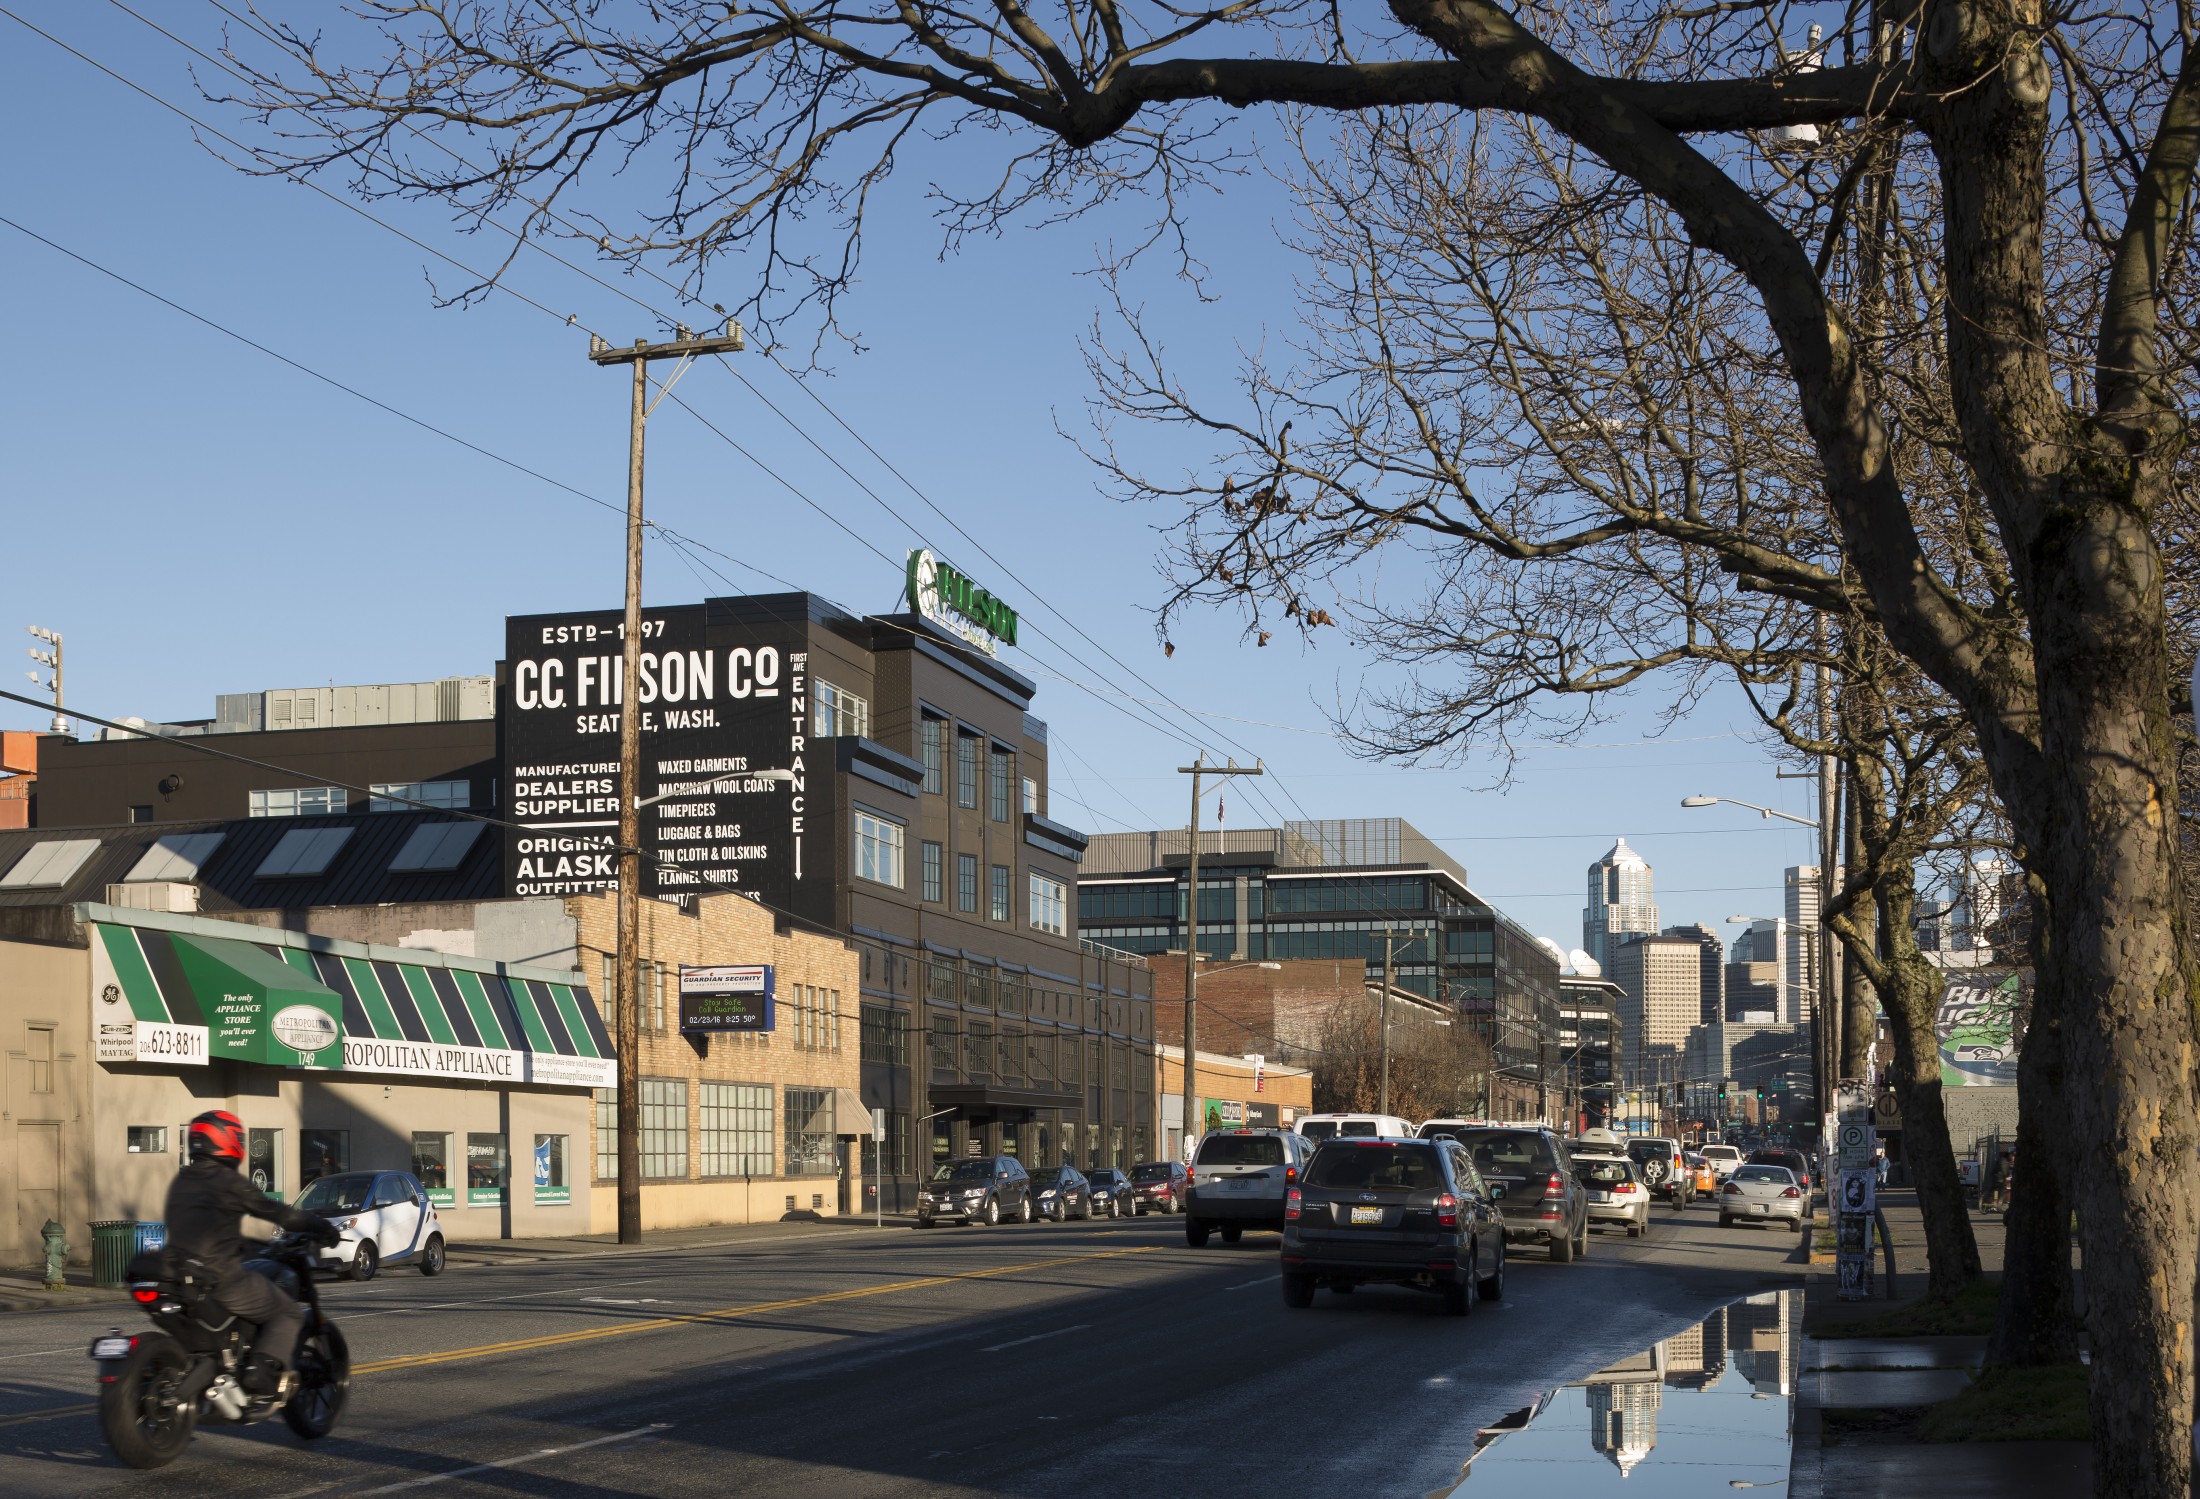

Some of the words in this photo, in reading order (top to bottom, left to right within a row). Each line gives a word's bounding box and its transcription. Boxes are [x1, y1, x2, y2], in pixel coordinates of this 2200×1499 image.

[790, 653, 808, 663] FIRST
[793, 663, 805, 672] AVE
[664, 709, 721, 730] WASH.
[658, 760, 692, 774] WAXED
[694, 757, 747, 773] GARMENTS
[515, 779, 613, 797] DEALERS
[713, 780, 741, 794] WOOL
[744, 779, 775, 793] COATS
[658, 803, 716, 818] TIMEPIECES
[658, 826, 702, 841] LUGGAGE
[704, 825, 713, 839] &
[715, 824, 741, 838] BAGS
[658, 849, 675, 863] TIN
[677, 847, 708, 862] CLOTH
[711, 847, 720, 860] &
[721, 845, 767, 860] OILSKINS
[516, 854, 619, 879] ALASK
[658, 870, 701, 885] FLANNEL
[703, 869, 739, 883] SHIRTS
[223, 994, 236, 1002] The
[237, 994, 253, 1003] only
[215, 1004, 261, 1013] APPLIANCE
[225, 1015, 251, 1024] STORE
[279, 1017, 332, 1029] METROPOLITAN
[689, 1016, 721, 1024] 02/23/16
[219, 1027, 240, 1036] you'll
[100, 1038, 134, 1047] Whirlpool
[228, 1038, 248, 1046] need!
[290, 1033, 324, 1044] APPLIANCE
[100, 1049, 134, 1057] MAYTAG
[139, 1041, 152, 1054] 206
[298, 1052, 315, 1066] 1749
[436, 1050, 512, 1076] APPLIANCE
